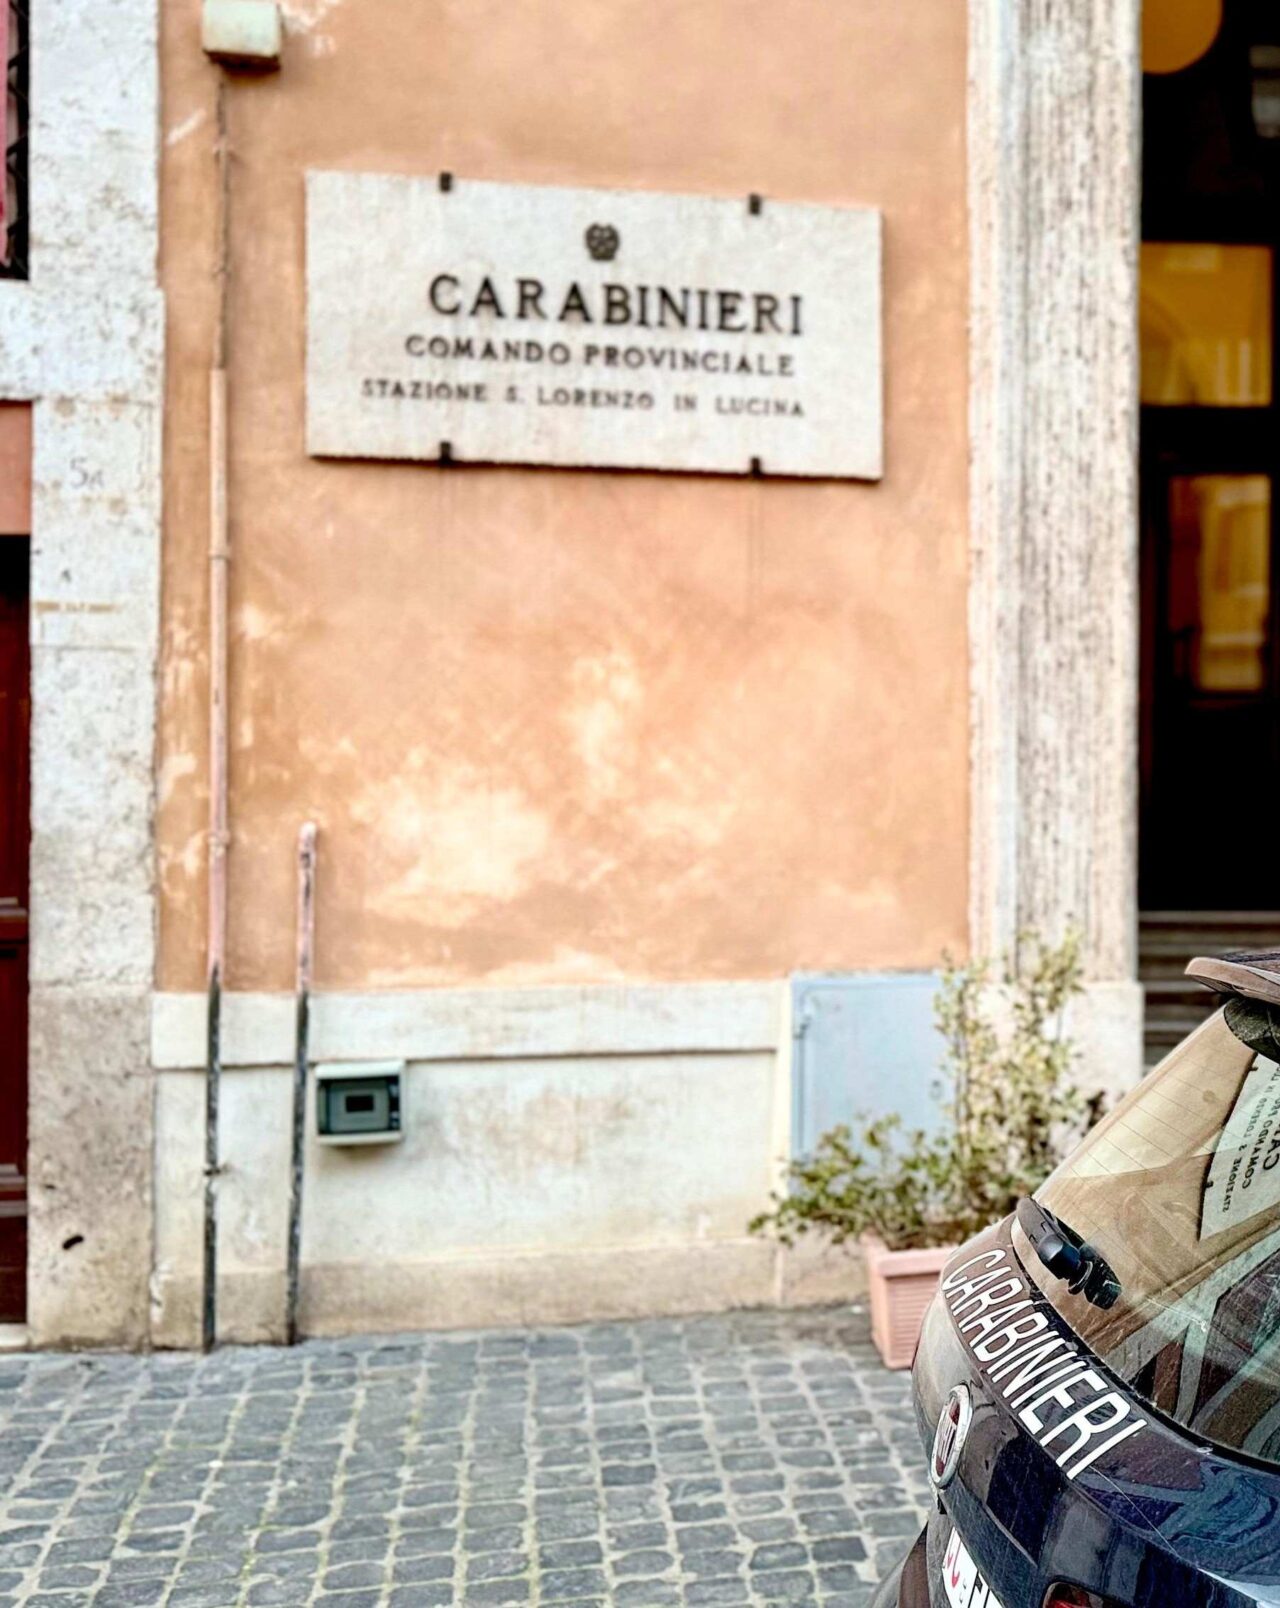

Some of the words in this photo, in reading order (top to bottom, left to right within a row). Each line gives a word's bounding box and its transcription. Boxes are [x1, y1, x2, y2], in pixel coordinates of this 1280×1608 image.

[428, 273, 803, 336] CARABINIERI
[404, 334, 572, 366] COMANDO
[583, 344, 795, 377] PROVINCIALE
[361, 377, 488, 401] STAZIONE
[537, 386, 655, 411] LORENZO
[674, 393, 698, 412] IN
[714, 396, 805, 417] LUCINA
[942, 1248, 1148, 1480] CARABINIERI
